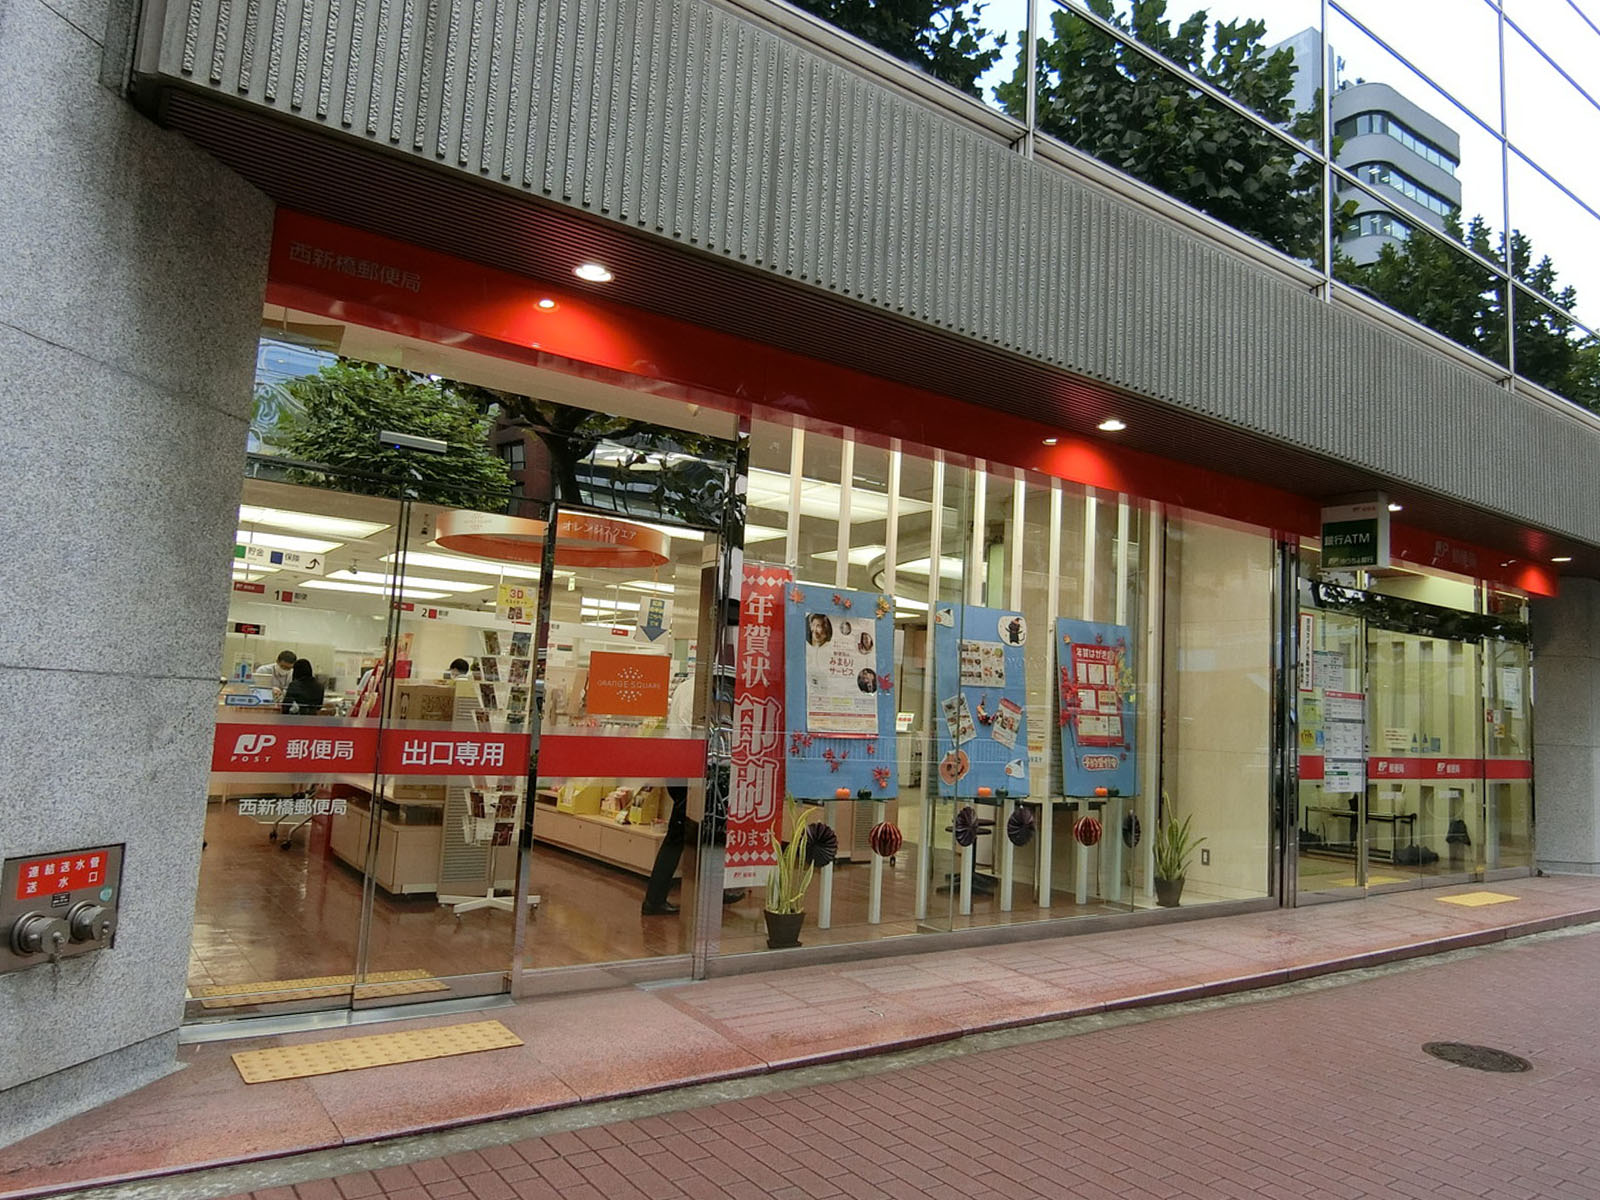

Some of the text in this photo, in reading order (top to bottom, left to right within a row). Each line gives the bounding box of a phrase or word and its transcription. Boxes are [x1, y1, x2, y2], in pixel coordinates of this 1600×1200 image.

[289, 241, 421, 293] 西新橋郵便局
[274, 590, 281, 601] 1
[509, 589, 524, 599] 3D
[421, 608, 428, 618] 2
[829, 657, 854, 667] みまもり
[829, 667, 855, 676] サービス
[286, 739, 354, 761] 郵便局
[401, 739, 505, 767] 出口専用
[230, 755, 273, 763] POST
[238, 798, 347, 817] 西新橋郵便局
[28, 856, 100, 879] 連結送水管
